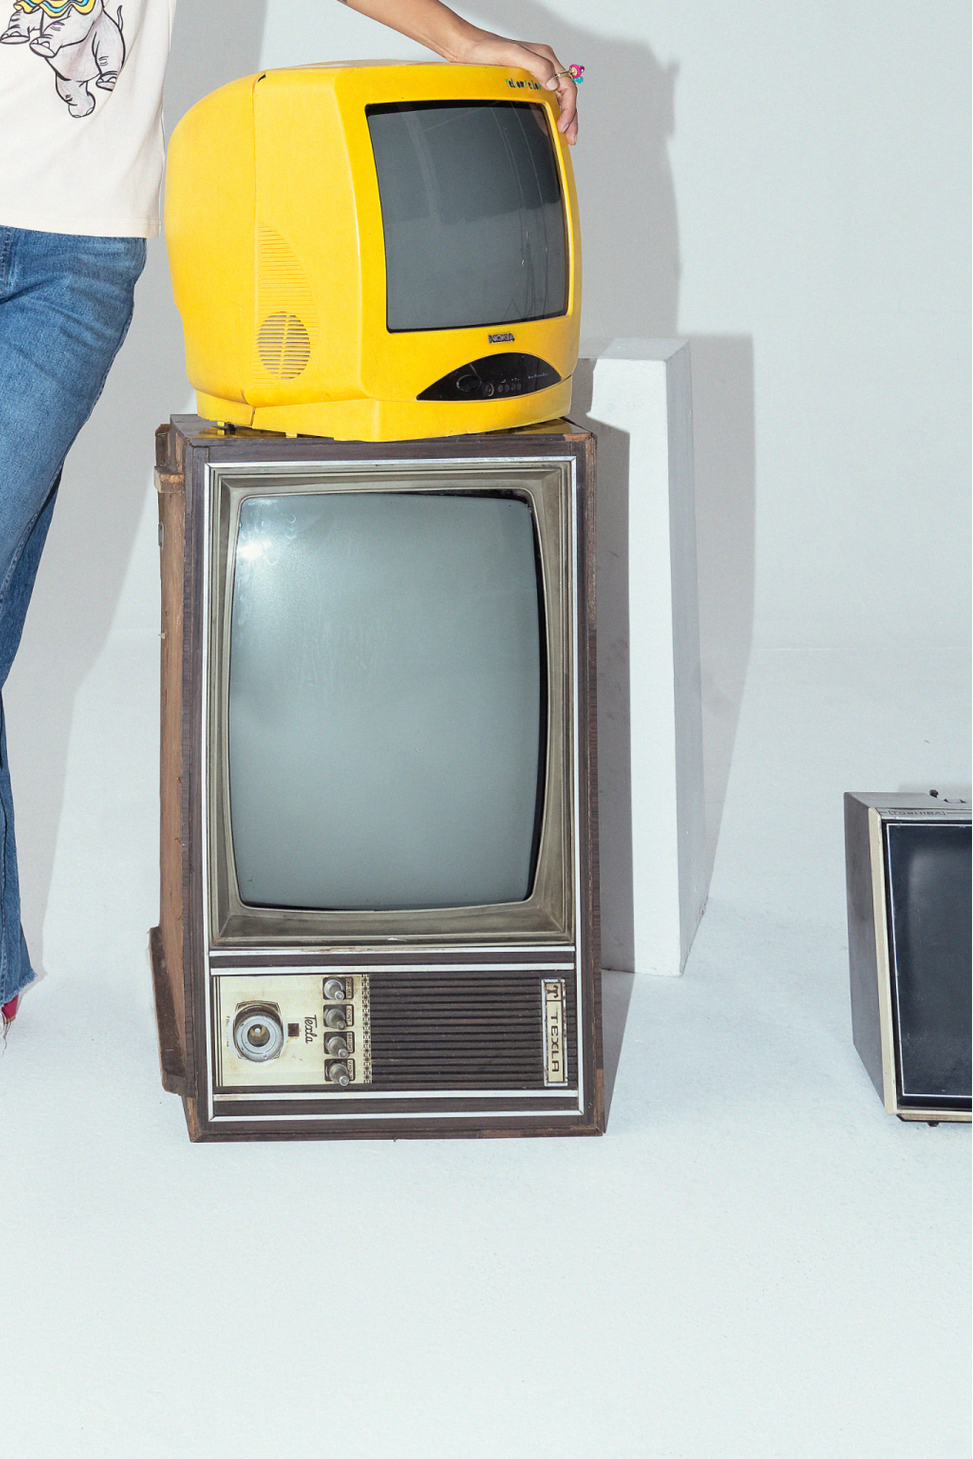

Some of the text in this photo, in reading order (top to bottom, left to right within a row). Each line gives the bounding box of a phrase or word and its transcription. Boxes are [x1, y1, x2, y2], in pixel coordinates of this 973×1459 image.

[488, 332, 516, 344] NOKIA
[304, 1014, 318, 1044] Texla
[550, 1010, 560, 1072] TEXLA
